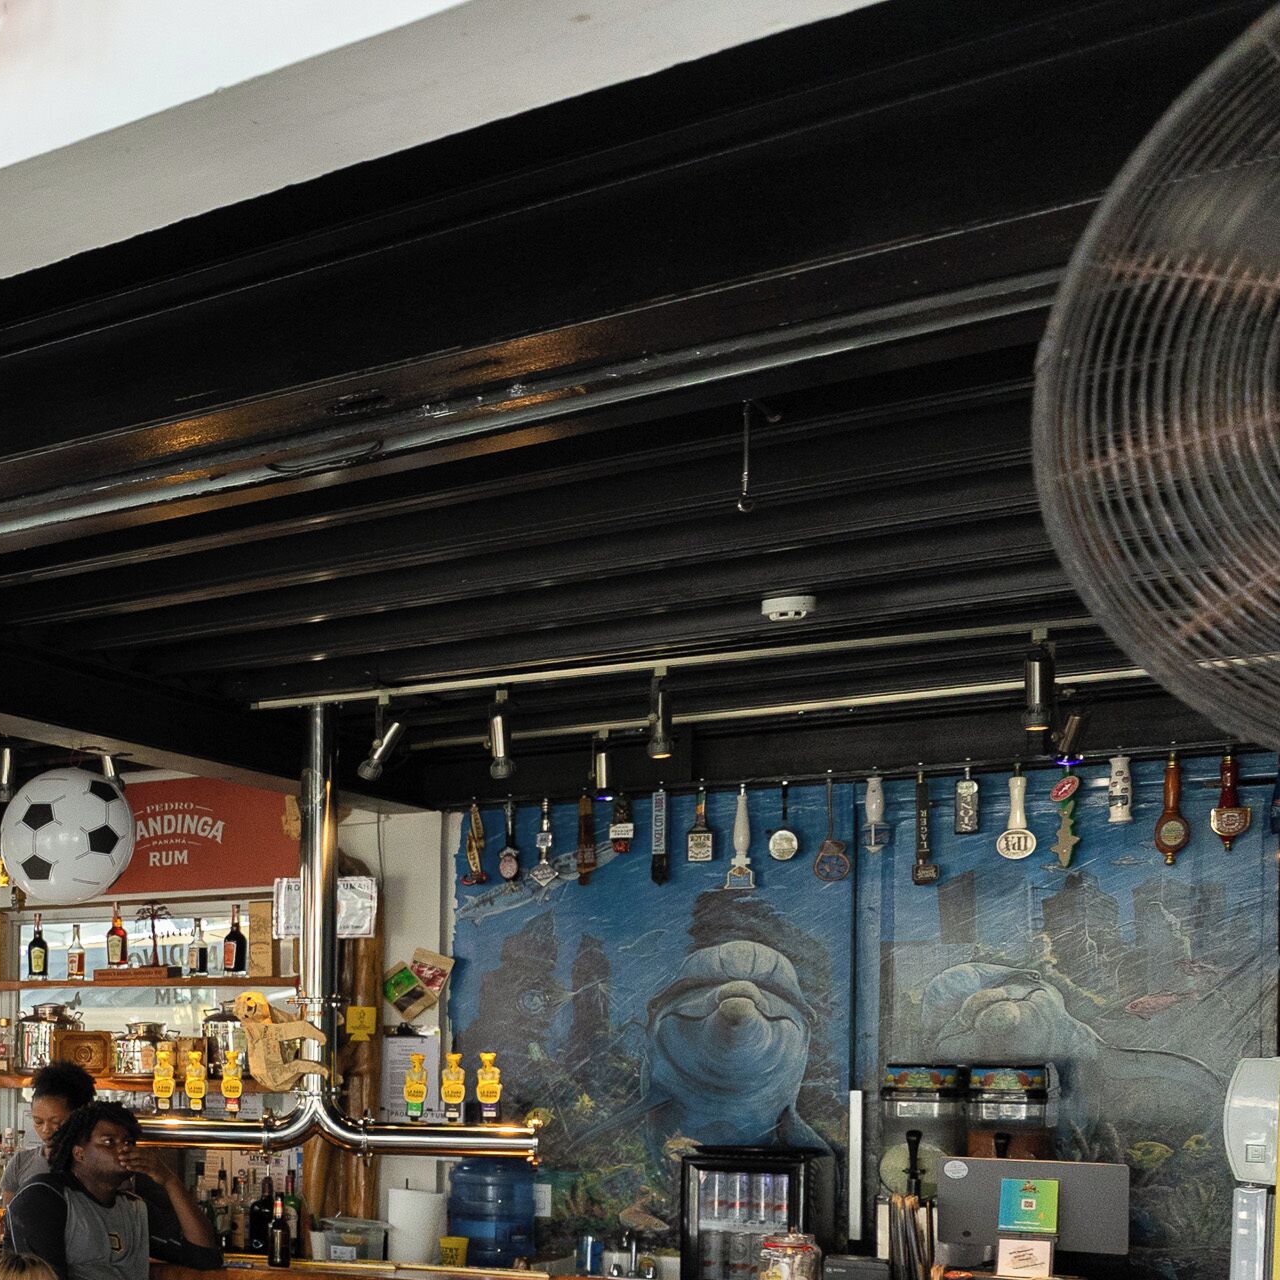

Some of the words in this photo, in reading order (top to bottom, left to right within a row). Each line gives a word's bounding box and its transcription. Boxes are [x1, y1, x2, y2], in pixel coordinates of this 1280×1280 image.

[146, 802, 194, 814] PEDRO
[136, 814, 225, 844] ANDINGA
[920, 809, 928, 849] LAGER
[1004, 835, 1028, 852] IPA
[149, 850, 189, 867] RUM
